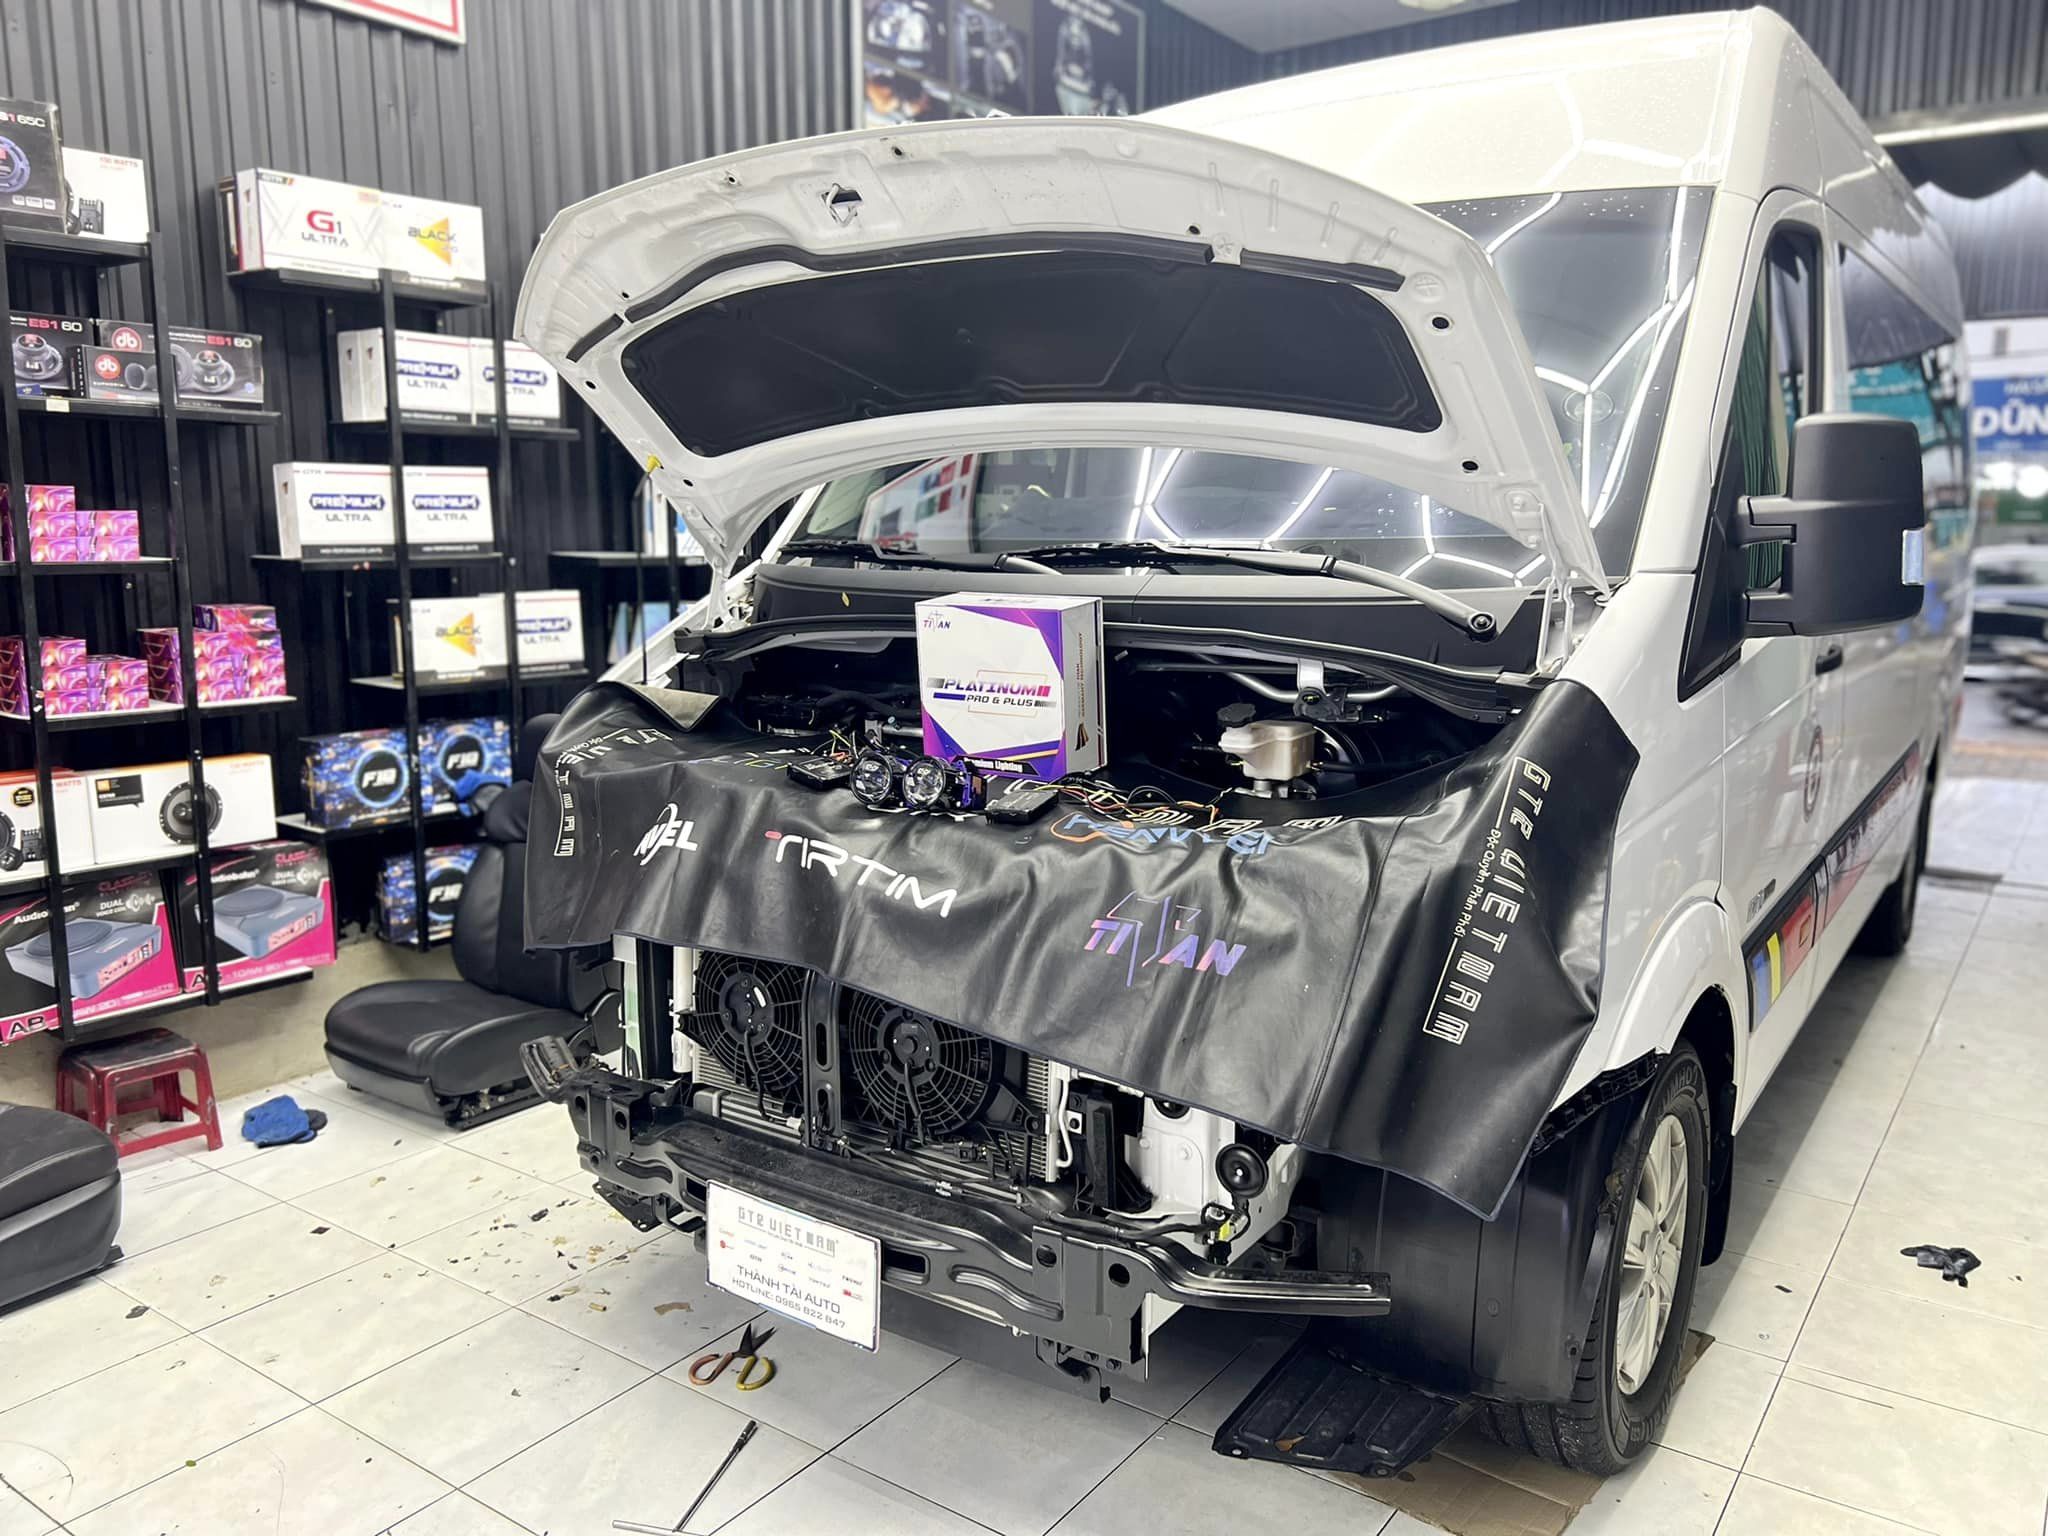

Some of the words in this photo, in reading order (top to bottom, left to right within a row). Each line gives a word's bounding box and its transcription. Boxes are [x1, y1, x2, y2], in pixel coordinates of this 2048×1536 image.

[301, 231, 349, 247] ULTRA
[408, 226, 457, 242] BLACK
[61, 321, 83, 332] 60
[407, 379, 448, 390] ULTRA
[326, 513, 372, 522] ULTRA
[427, 513, 469, 522] ULTRA
[944, 679, 1037, 697] PLATINUM
[967, 694, 989, 704] PRO
[1003, 698, 1033, 707] PLUS
[210, 870, 260, 884] udiobahn
[100, 900, 124, 911] DUAL
[805, 1292, 840, 1314] AUTO
